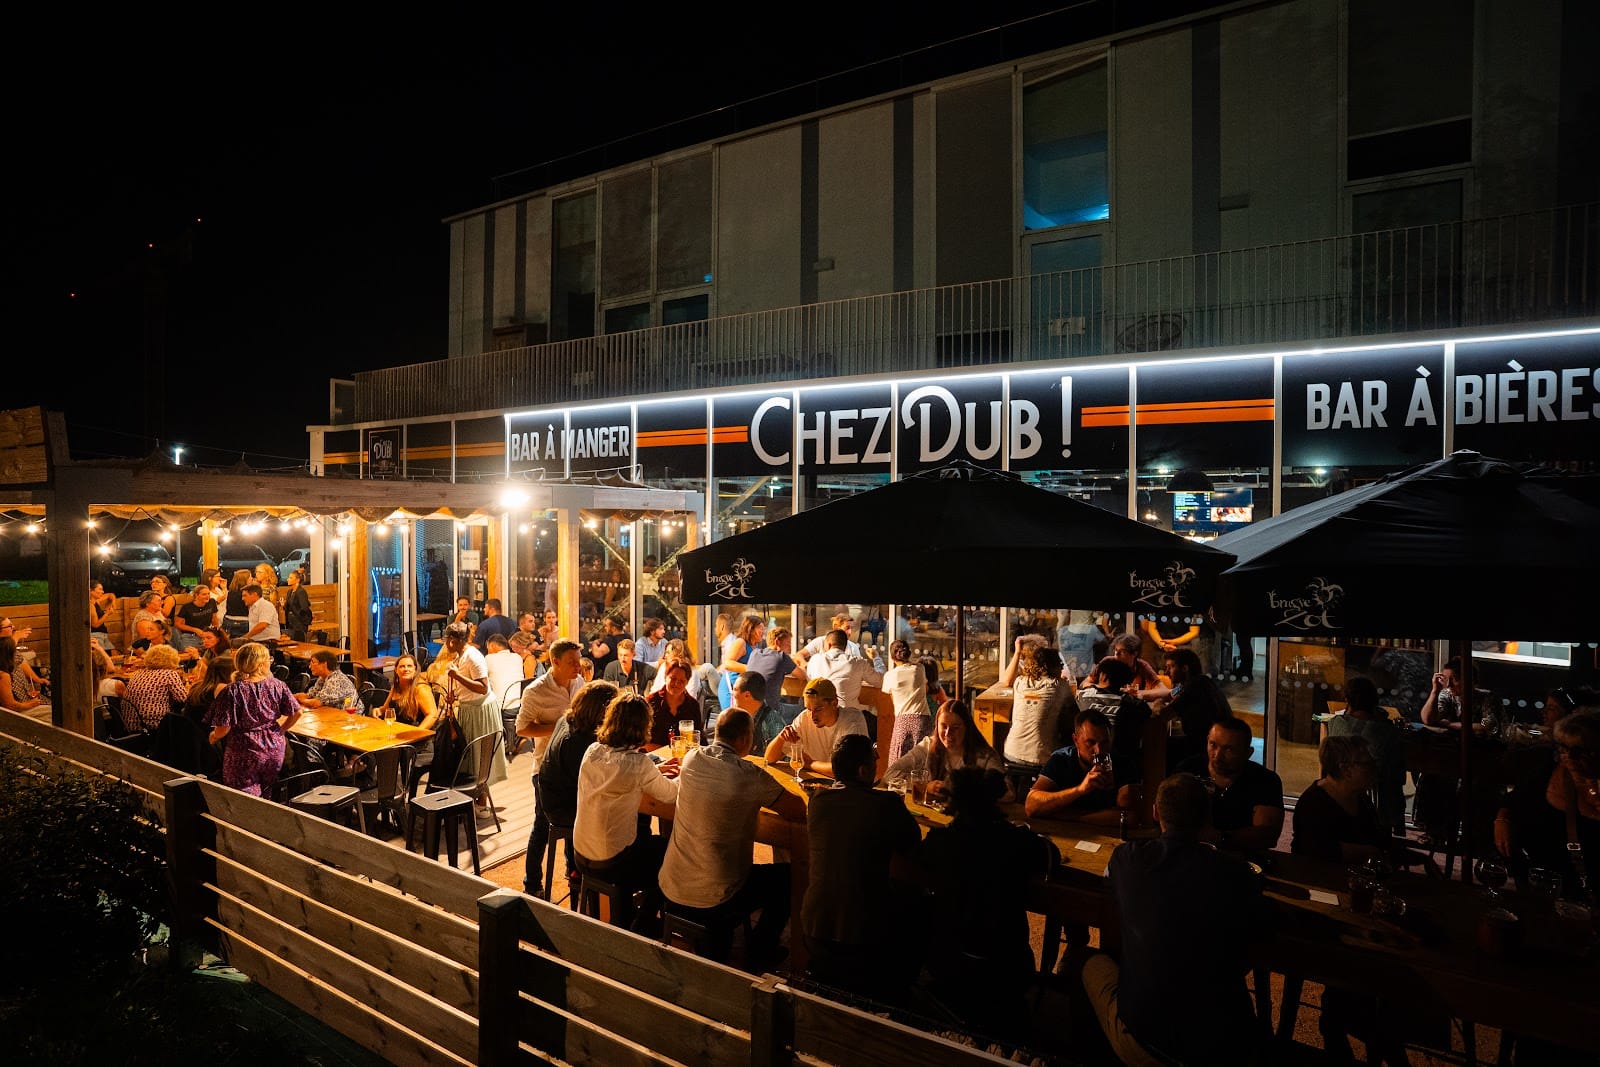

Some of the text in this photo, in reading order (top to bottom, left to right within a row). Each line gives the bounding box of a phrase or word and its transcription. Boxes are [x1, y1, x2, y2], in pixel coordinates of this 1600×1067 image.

[751, 376, 1074, 466] CHEZ DUB !
[1306, 379, 1389, 431] BAR
[1404, 364, 1438, 428] À
[511, 423, 630, 461] BAR À MANGER
